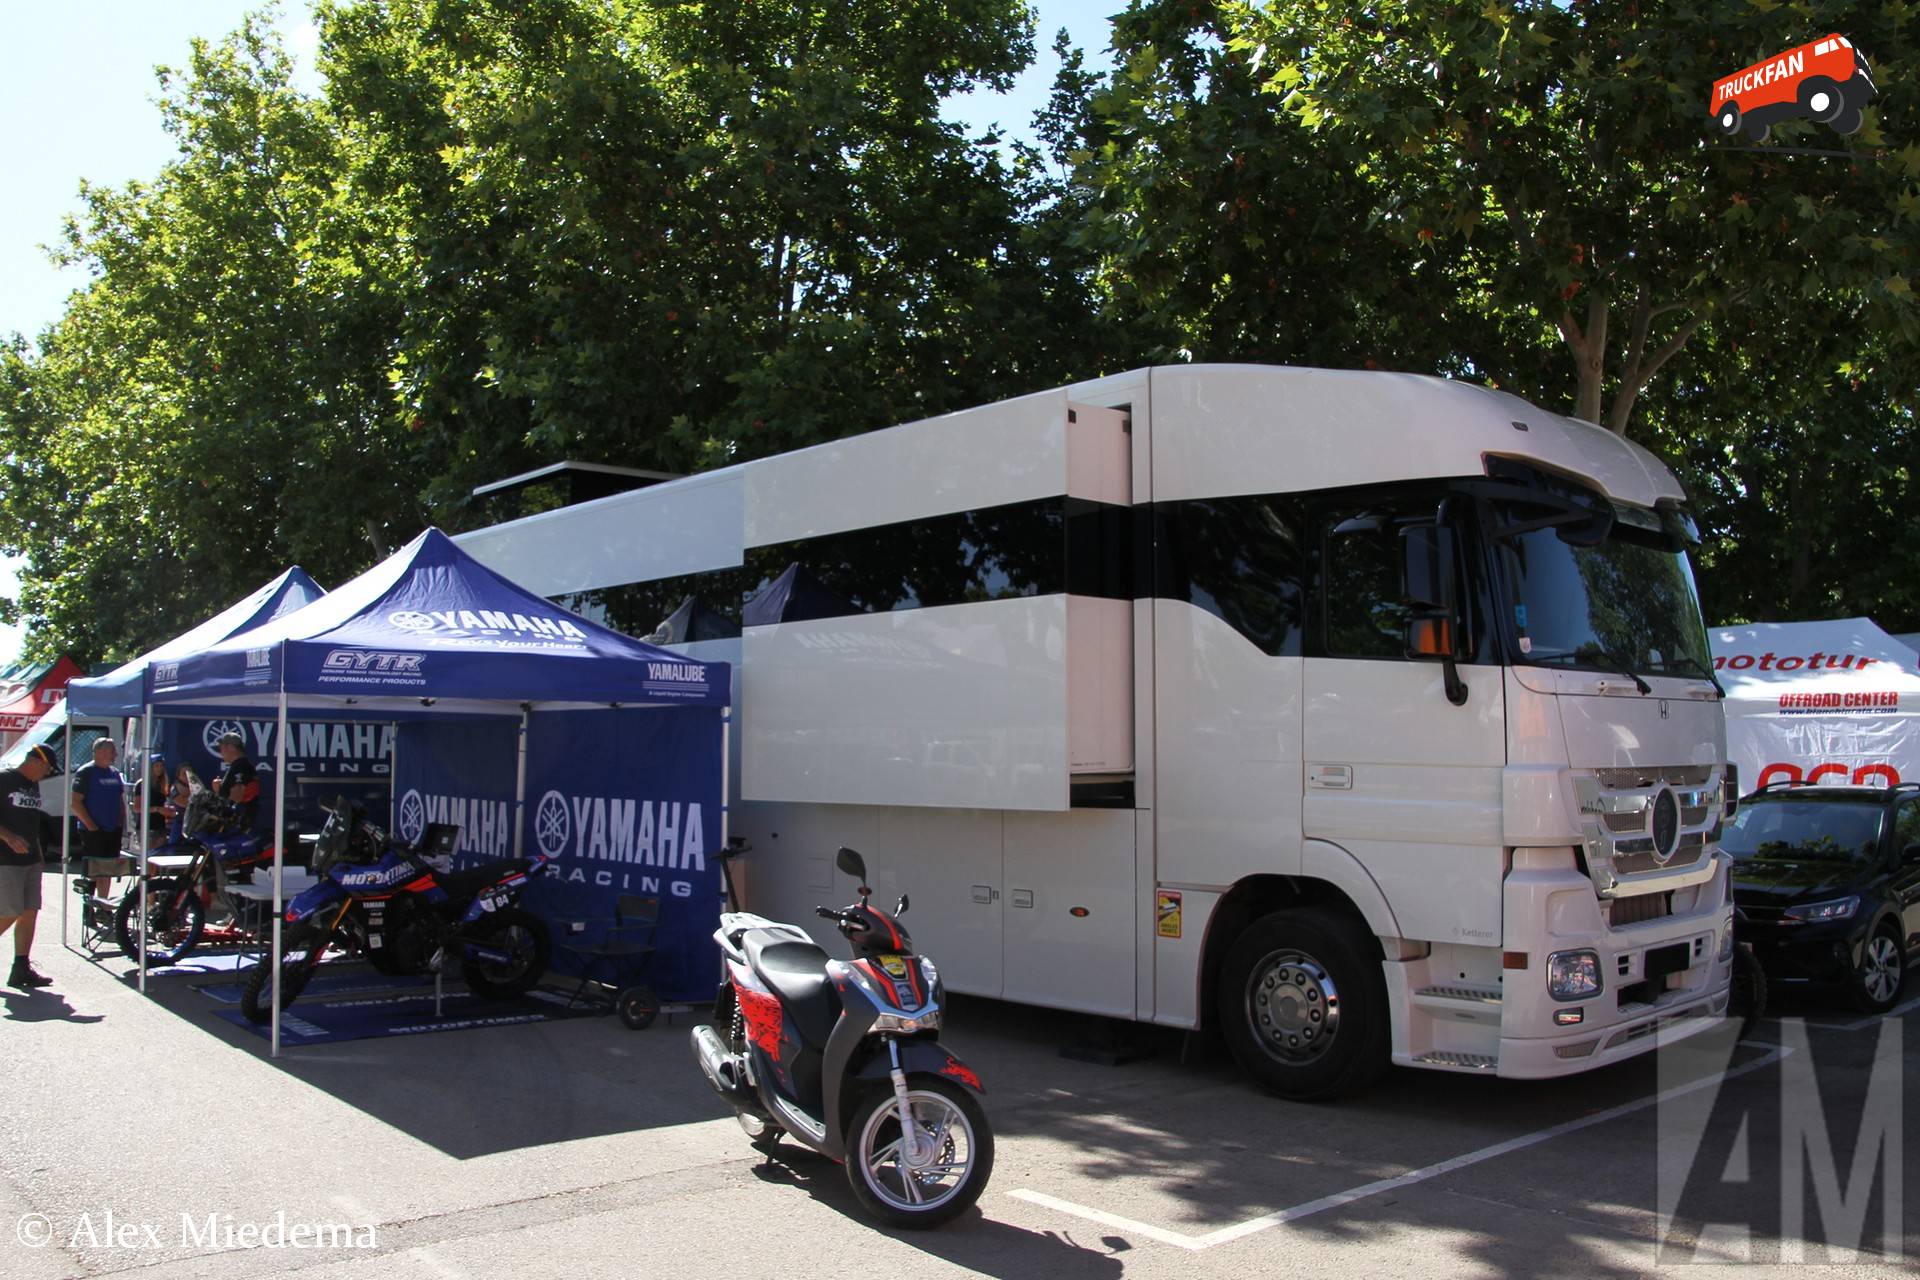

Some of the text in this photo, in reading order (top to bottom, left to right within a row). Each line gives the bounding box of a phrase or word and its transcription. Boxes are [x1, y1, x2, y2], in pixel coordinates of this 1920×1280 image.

[431, 610, 587, 639] YAMAHA
[323, 649, 424, 672] GYTR
[648, 663, 705, 682] YAMALUBE
[318, 676, 381, 684] PERFORMANCE
[1779, 691, 1898, 708] OFFROAD CENTER
[251, 721, 398, 759] YAMAHA
[572, 796, 706, 872] YAMAHA
[545, 863, 692, 897] RACING
